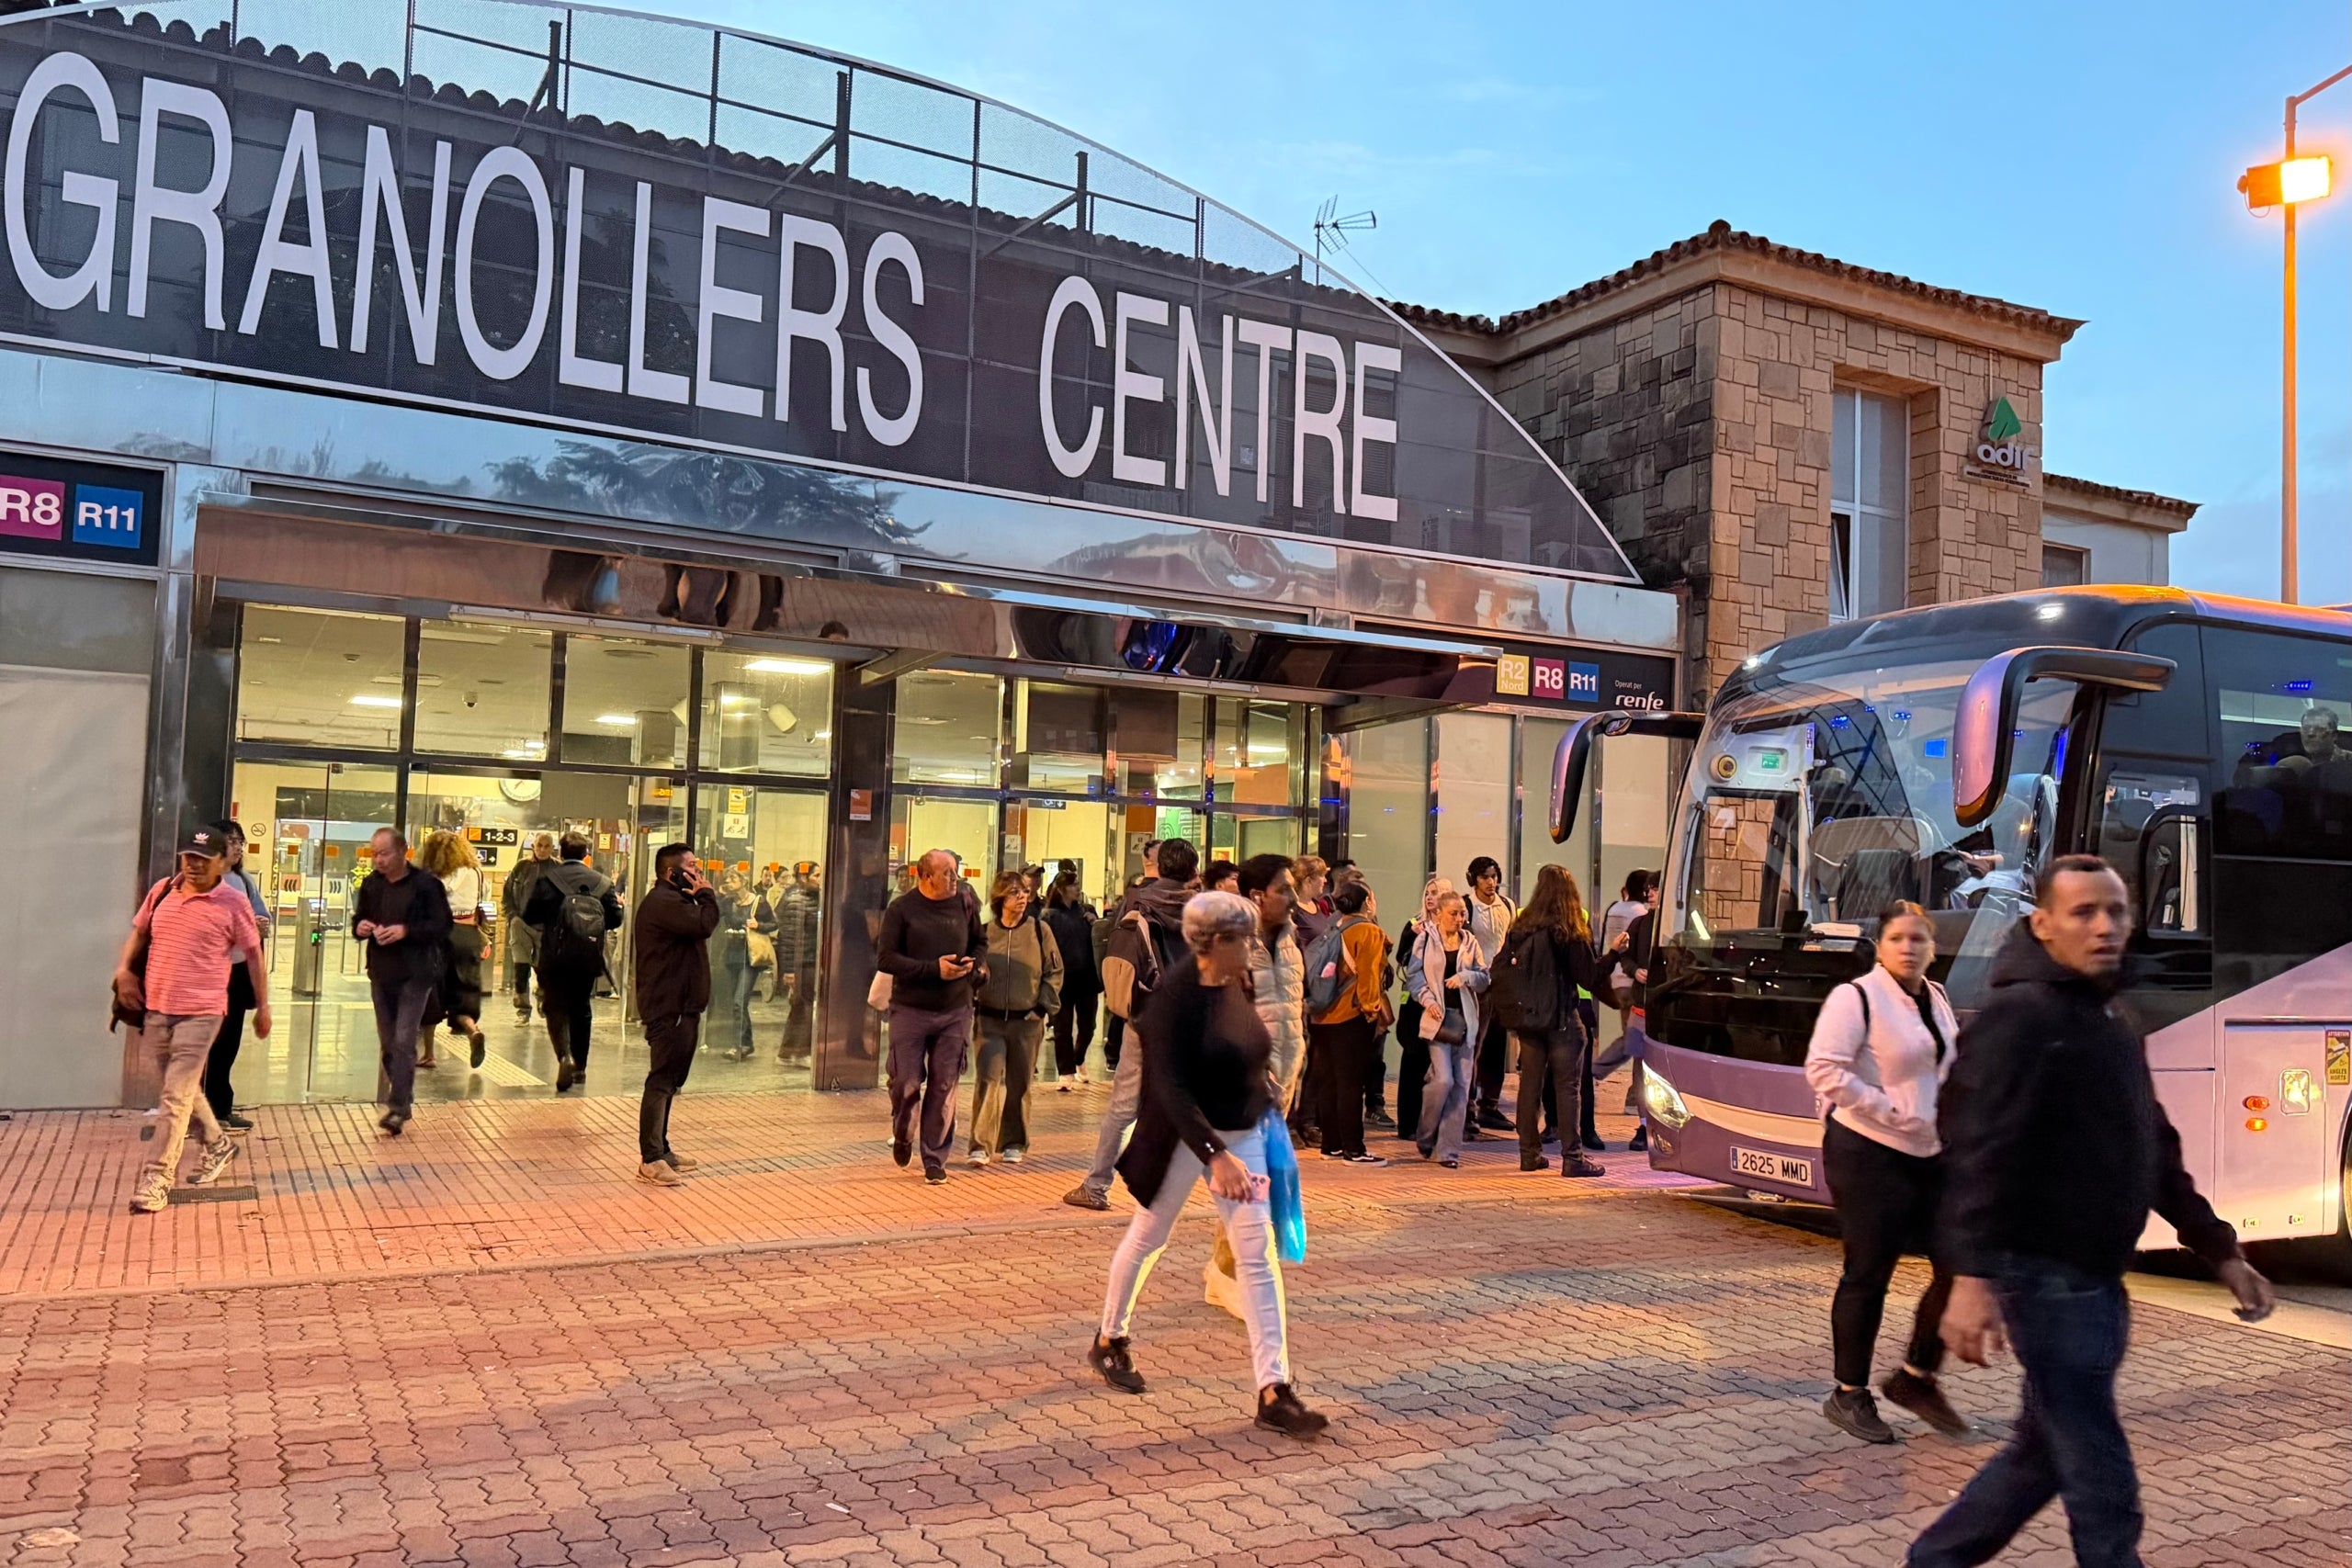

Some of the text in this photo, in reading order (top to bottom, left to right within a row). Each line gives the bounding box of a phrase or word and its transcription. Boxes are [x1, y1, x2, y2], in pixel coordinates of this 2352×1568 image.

[4, 51, 1402, 522] GRANOLLERS CENTRE
[1977, 442, 2034, 470] adif
[0, 487, 135, 532] R8 R11
[1500, 660, 1597, 692] R2 R8 R11
[1501, 680, 1524, 692] Nord
[1614, 680, 1643, 691] Operat per
[1615, 691, 1664, 712] renfe
[485, 831, 515, 842] 1-2-3
[1742, 1153, 1775, 1175] 2625
[1781, 1159, 1808, 1182] MMD
